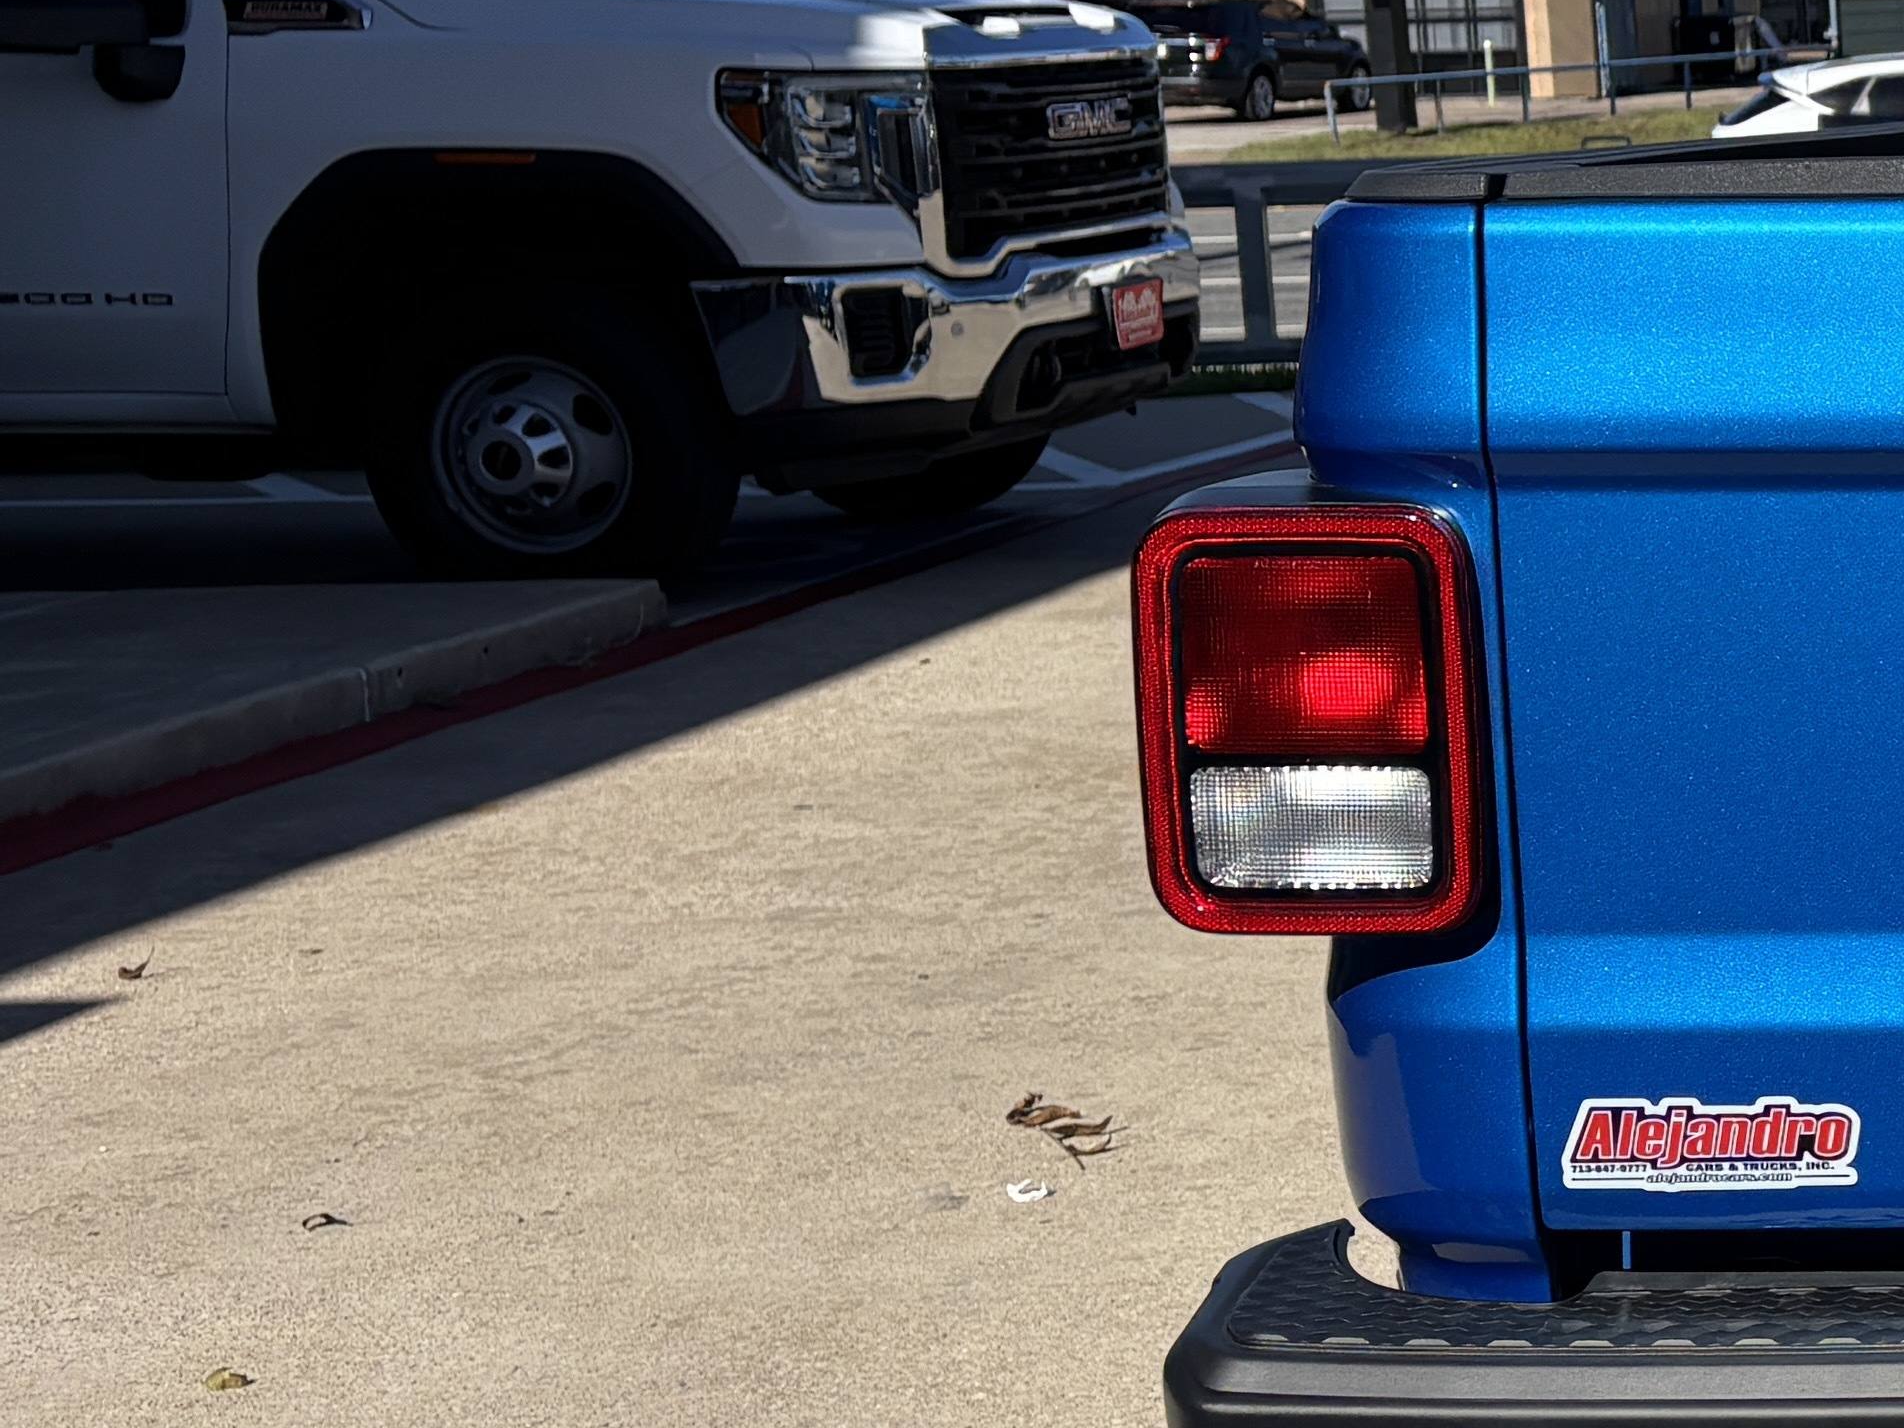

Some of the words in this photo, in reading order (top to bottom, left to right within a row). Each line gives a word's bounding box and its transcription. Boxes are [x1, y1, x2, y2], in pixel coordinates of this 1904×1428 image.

[1047, 97, 1137, 139] GMC
[104, 292, 173, 305] HD
[1573, 1106, 1852, 1170] Alejandro
[1686, 1163, 1724, 1172] CARS
[1728, 1163, 1738, 1172] &
[1806, 1161, 1835, 1171] INC.
